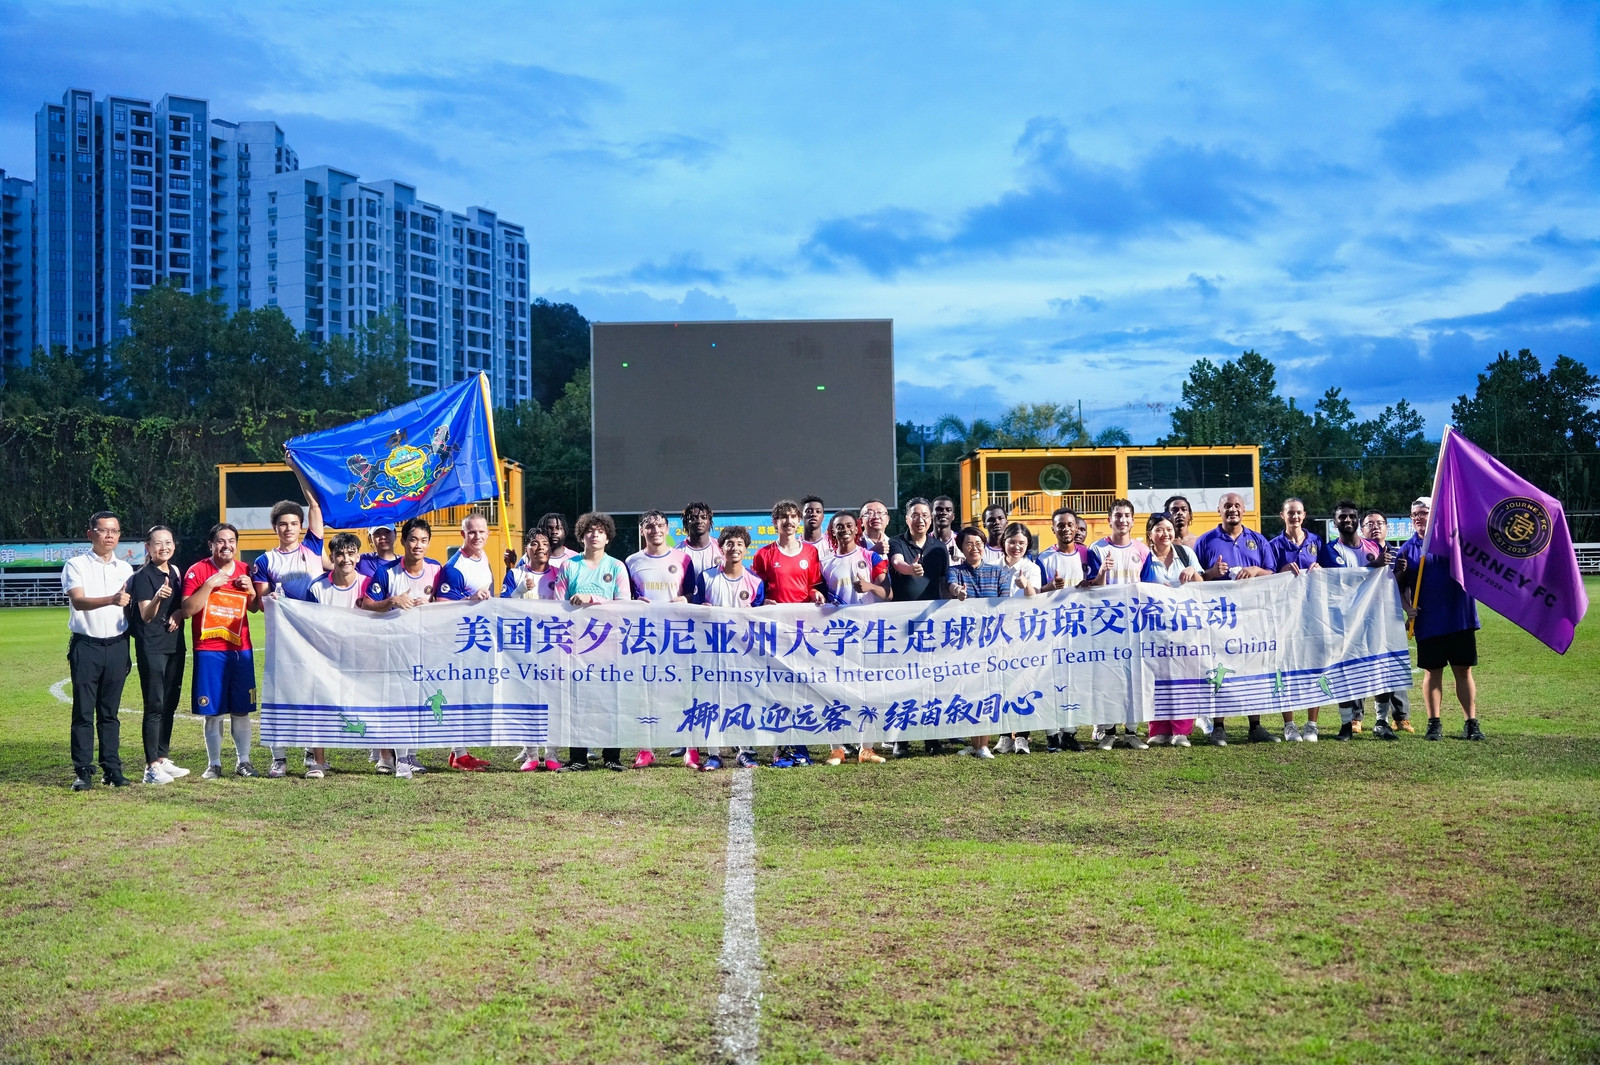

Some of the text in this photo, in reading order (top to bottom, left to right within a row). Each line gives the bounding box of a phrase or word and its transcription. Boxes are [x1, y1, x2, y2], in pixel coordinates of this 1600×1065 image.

[1505, 502, 1547, 530] JOURNEY FC
[1449, 527, 1557, 608] JURNEY FC
[1507, 545, 1527, 553] 2026
[454, 597, 1237, 657] 美国宾夕法尼亚州大学生足球队访琼交流活动
[412, 637, 1277, 687] Exchange Visit of the U.S. Pennsylvania Intercollegiate Soccer Team to Hainan, China
[676, 690, 1043, 740] 椰风迎远客 绿茵叙同心
